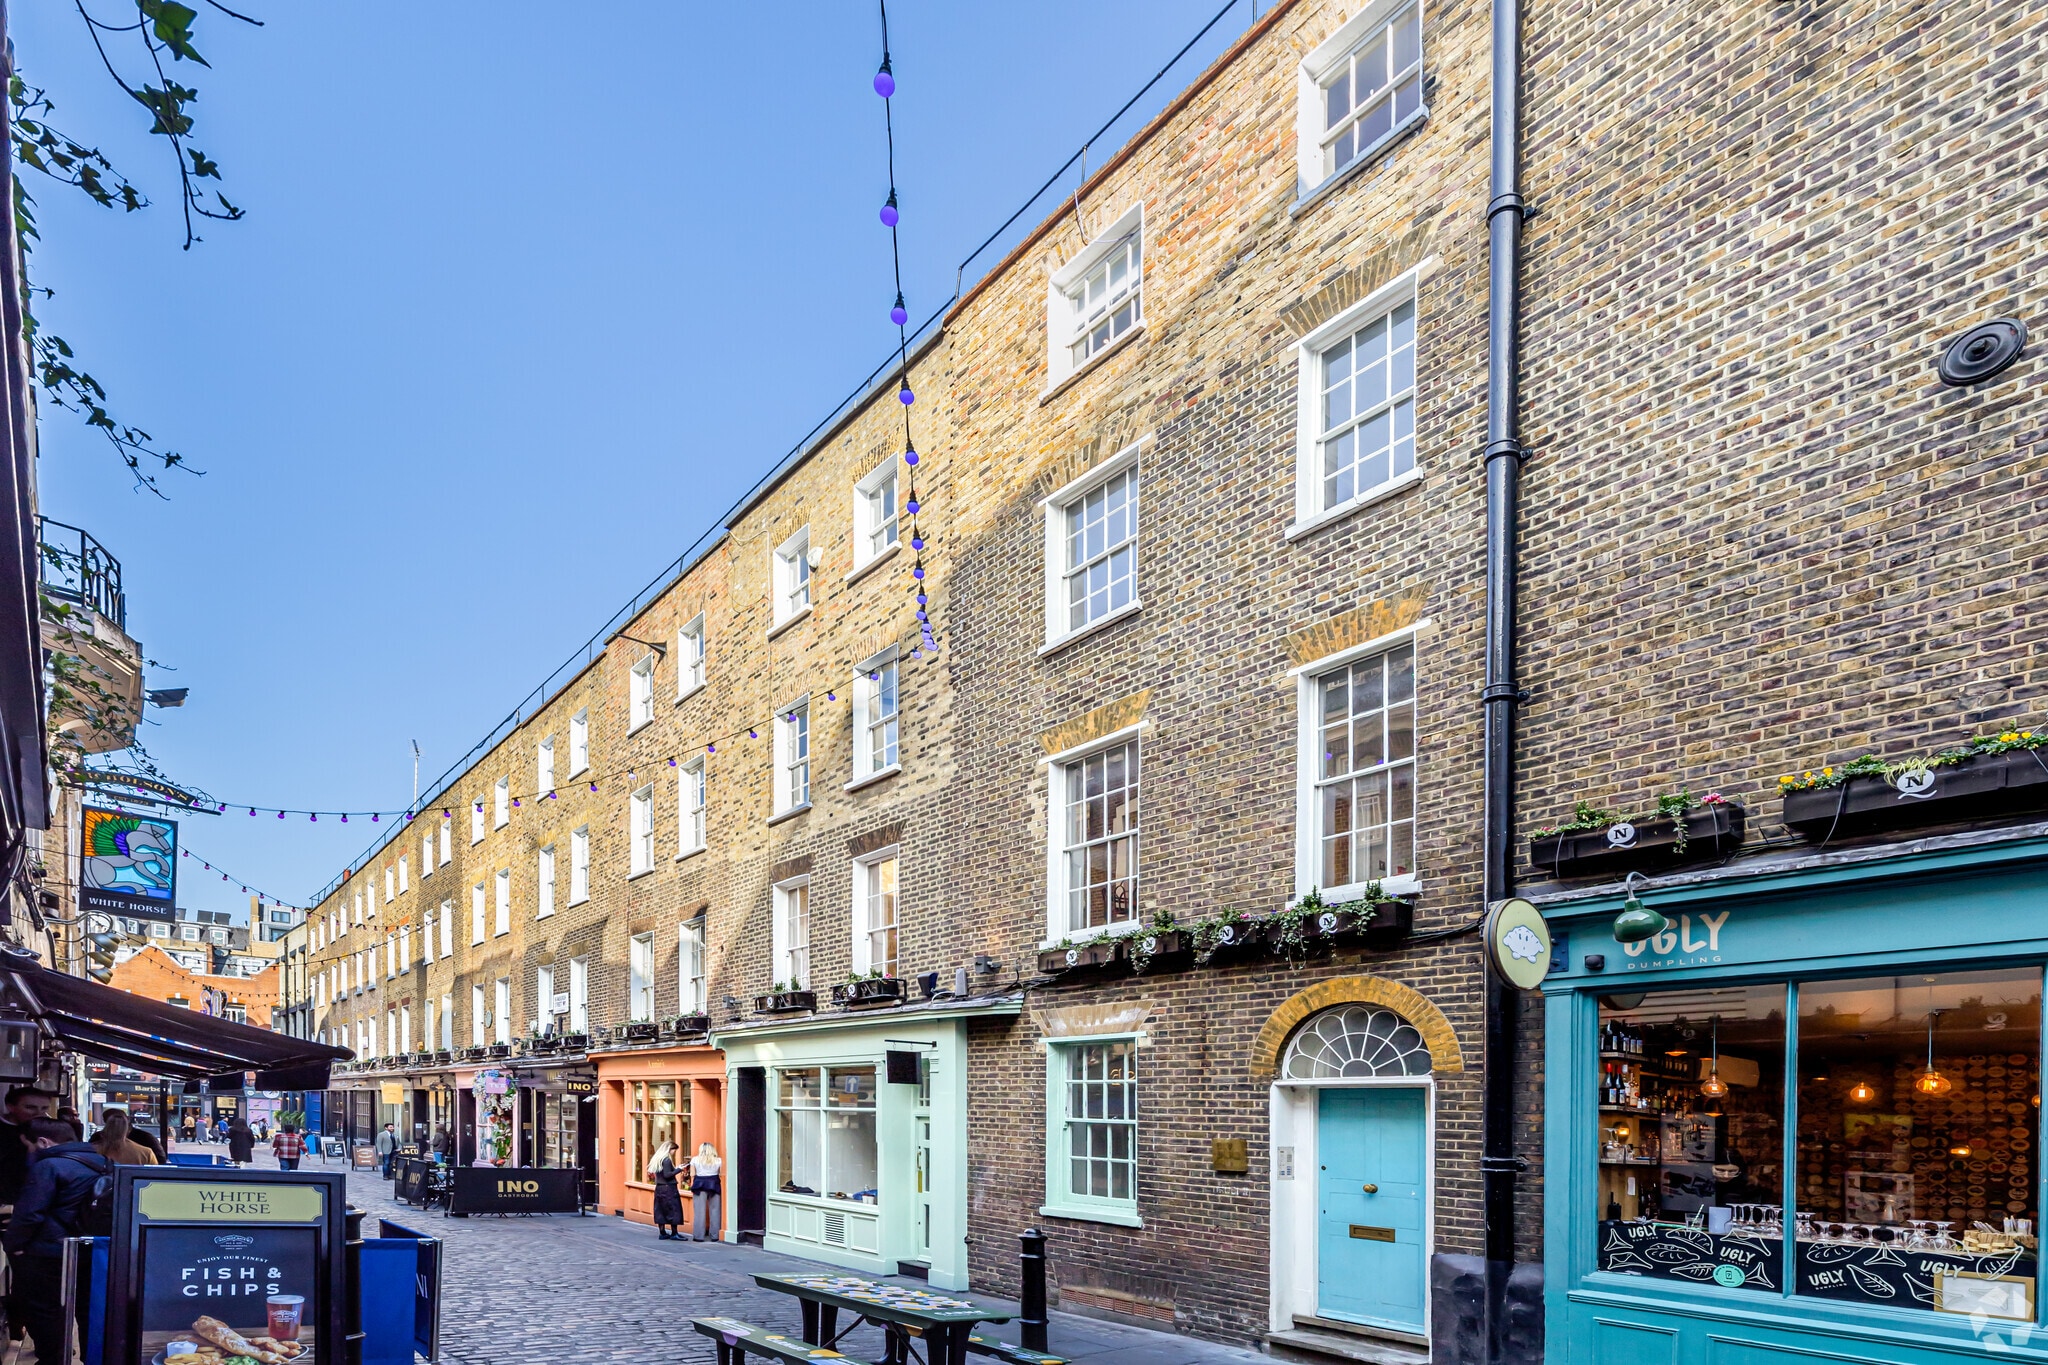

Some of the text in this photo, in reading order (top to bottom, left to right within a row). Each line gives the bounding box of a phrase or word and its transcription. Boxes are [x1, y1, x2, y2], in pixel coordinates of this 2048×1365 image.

[89, 897, 167, 915] WHITE HORSE
[1627, 955, 1722, 970] DUMPLING
[568, 1082, 591, 1091] INO
[497, 1180, 539, 1193] INO
[198, 1190, 268, 1203] WHITE
[200, 1202, 271, 1215] HORSE
[1628, 1224, 1657, 1238] UGLY
[197, 1256, 221, 1264] ENJOY
[242, 1255, 269, 1264] FINEST
[1720, 1246, 1756, 1264] UGLY
[181, 1267, 282, 1280] FISH &
[1920, 1259, 1965, 1280] UGLY
[1808, 1269, 1844, 1286] UGLY
[182, 1283, 280, 1297] CHIPS
